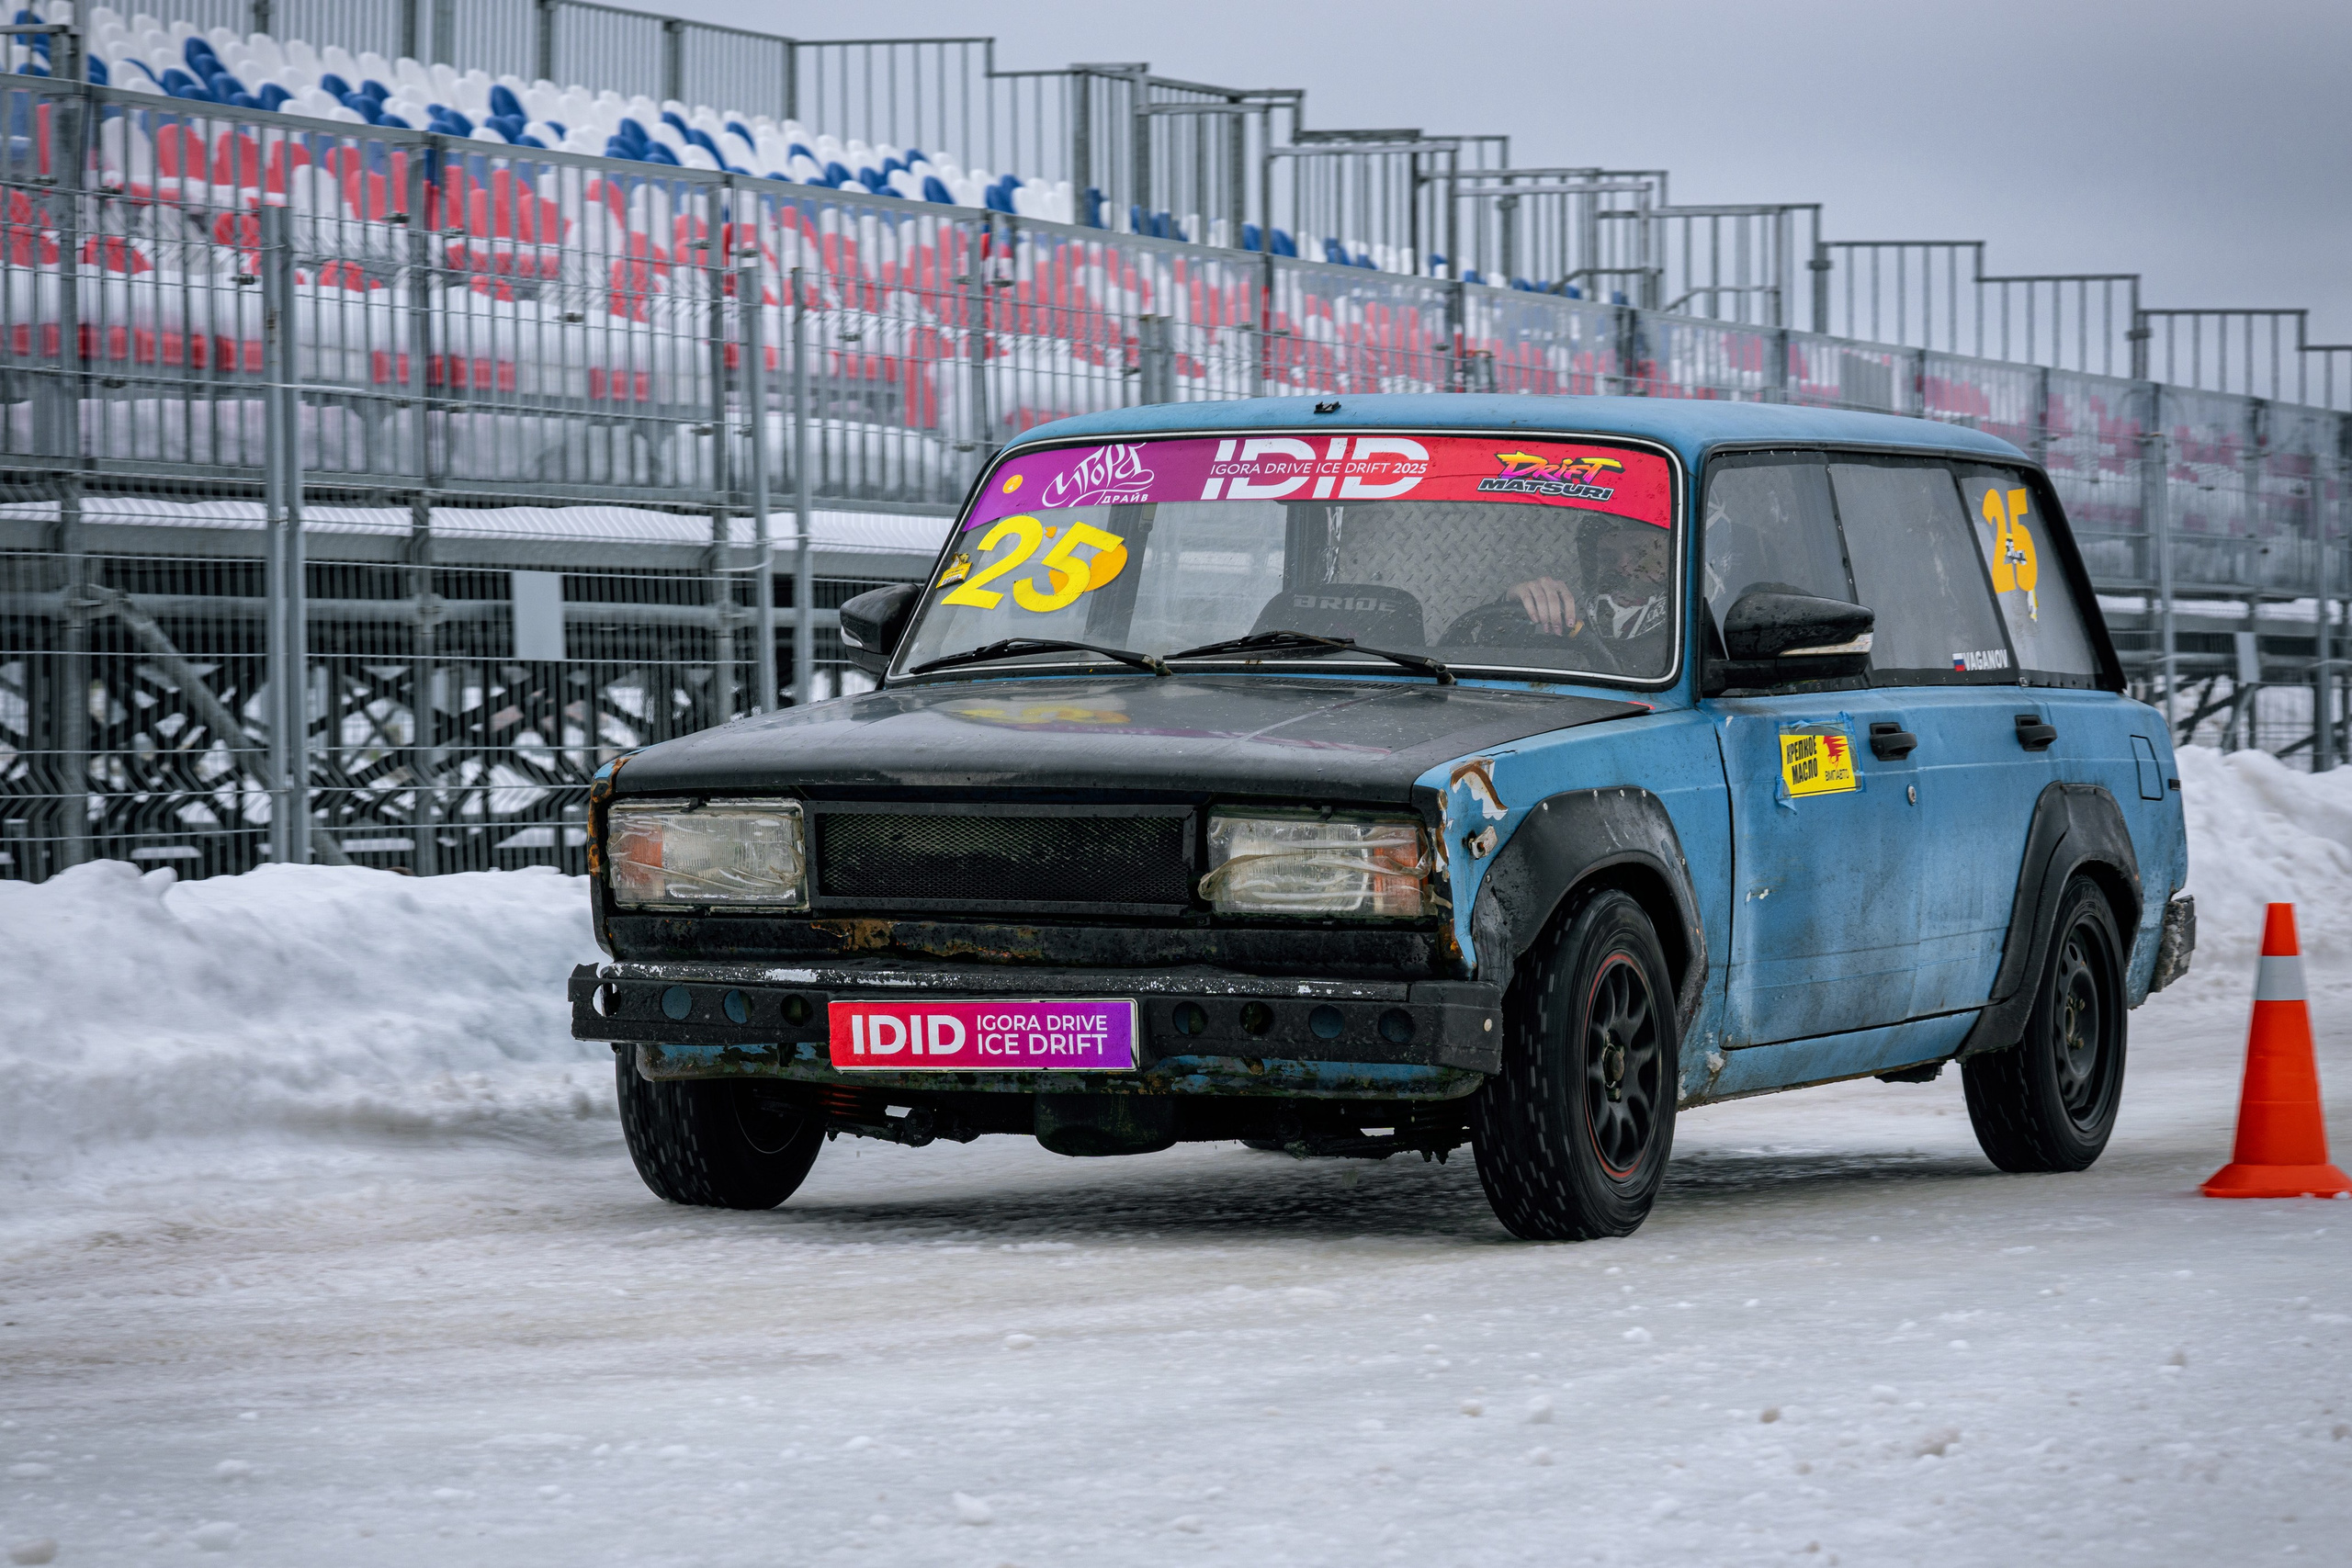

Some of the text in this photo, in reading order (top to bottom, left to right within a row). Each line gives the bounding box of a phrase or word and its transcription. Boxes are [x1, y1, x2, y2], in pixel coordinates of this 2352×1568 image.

[1200, 437, 1430, 501] IDID
[1210, 462, 1428, 475] IGORA DRIVE ICE DRIFT 2025
[1101, 492, 1149, 504] ДРАЙВ
[1477, 478, 1615, 502] MATSURI
[1982, 488, 2038, 594] 25
[940, 515, 1125, 613] 25
[1292, 593, 1399, 615] BRIDE
[1962, 649, 2008, 671] VAGANOV
[1786, 735, 1817, 764] КРЕПКОЕ
[1792, 757, 1818, 785] МАСЛО
[851, 1014, 967, 1055] IDID
[977, 1014, 1108, 1032] IGORA DRIVE
[977, 1033, 1108, 1055] ICE DRIFT
